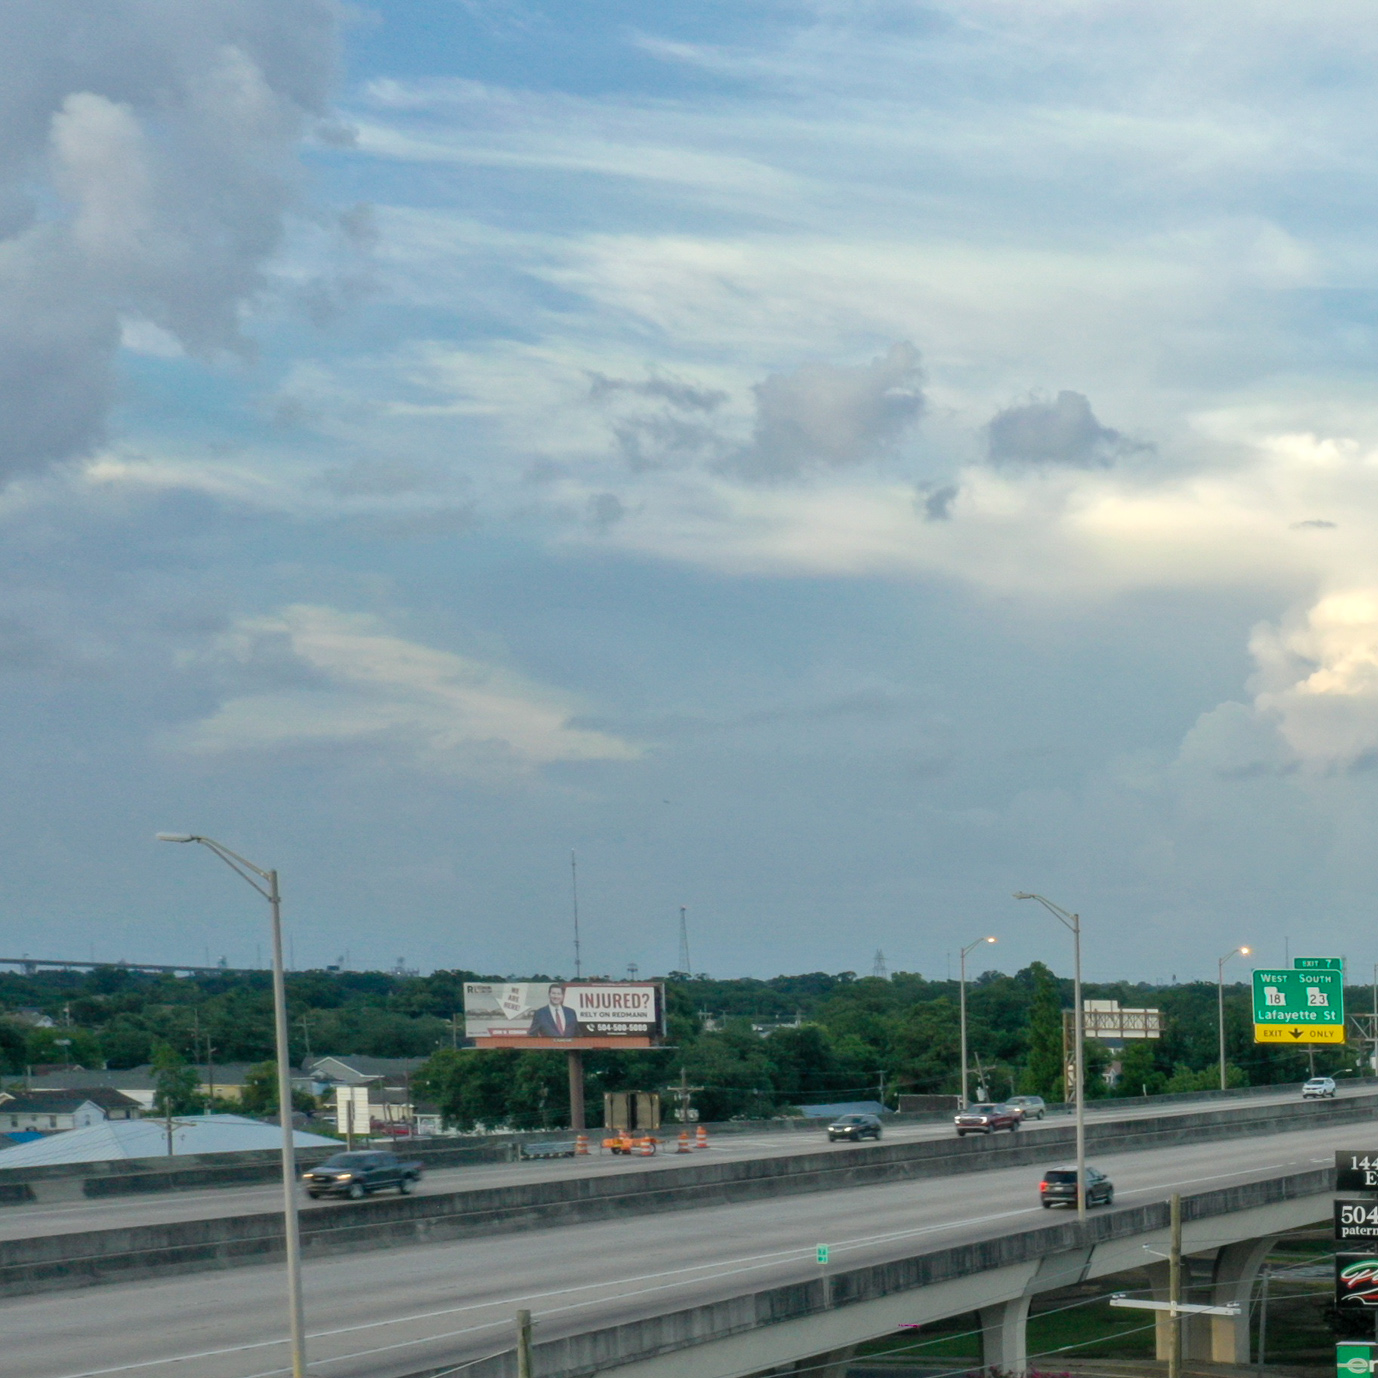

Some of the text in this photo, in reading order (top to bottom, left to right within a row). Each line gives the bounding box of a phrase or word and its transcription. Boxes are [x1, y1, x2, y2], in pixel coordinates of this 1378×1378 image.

[1325, 959, 1331, 968] 7
[580, 993, 650, 1009] INJURED?
[1269, 994, 1281, 1004] 18
[1310, 994, 1326, 1004] 23
[1258, 1010, 1336, 1023] Lafayette St
[1309, 1030, 1334, 1038] ONLY
